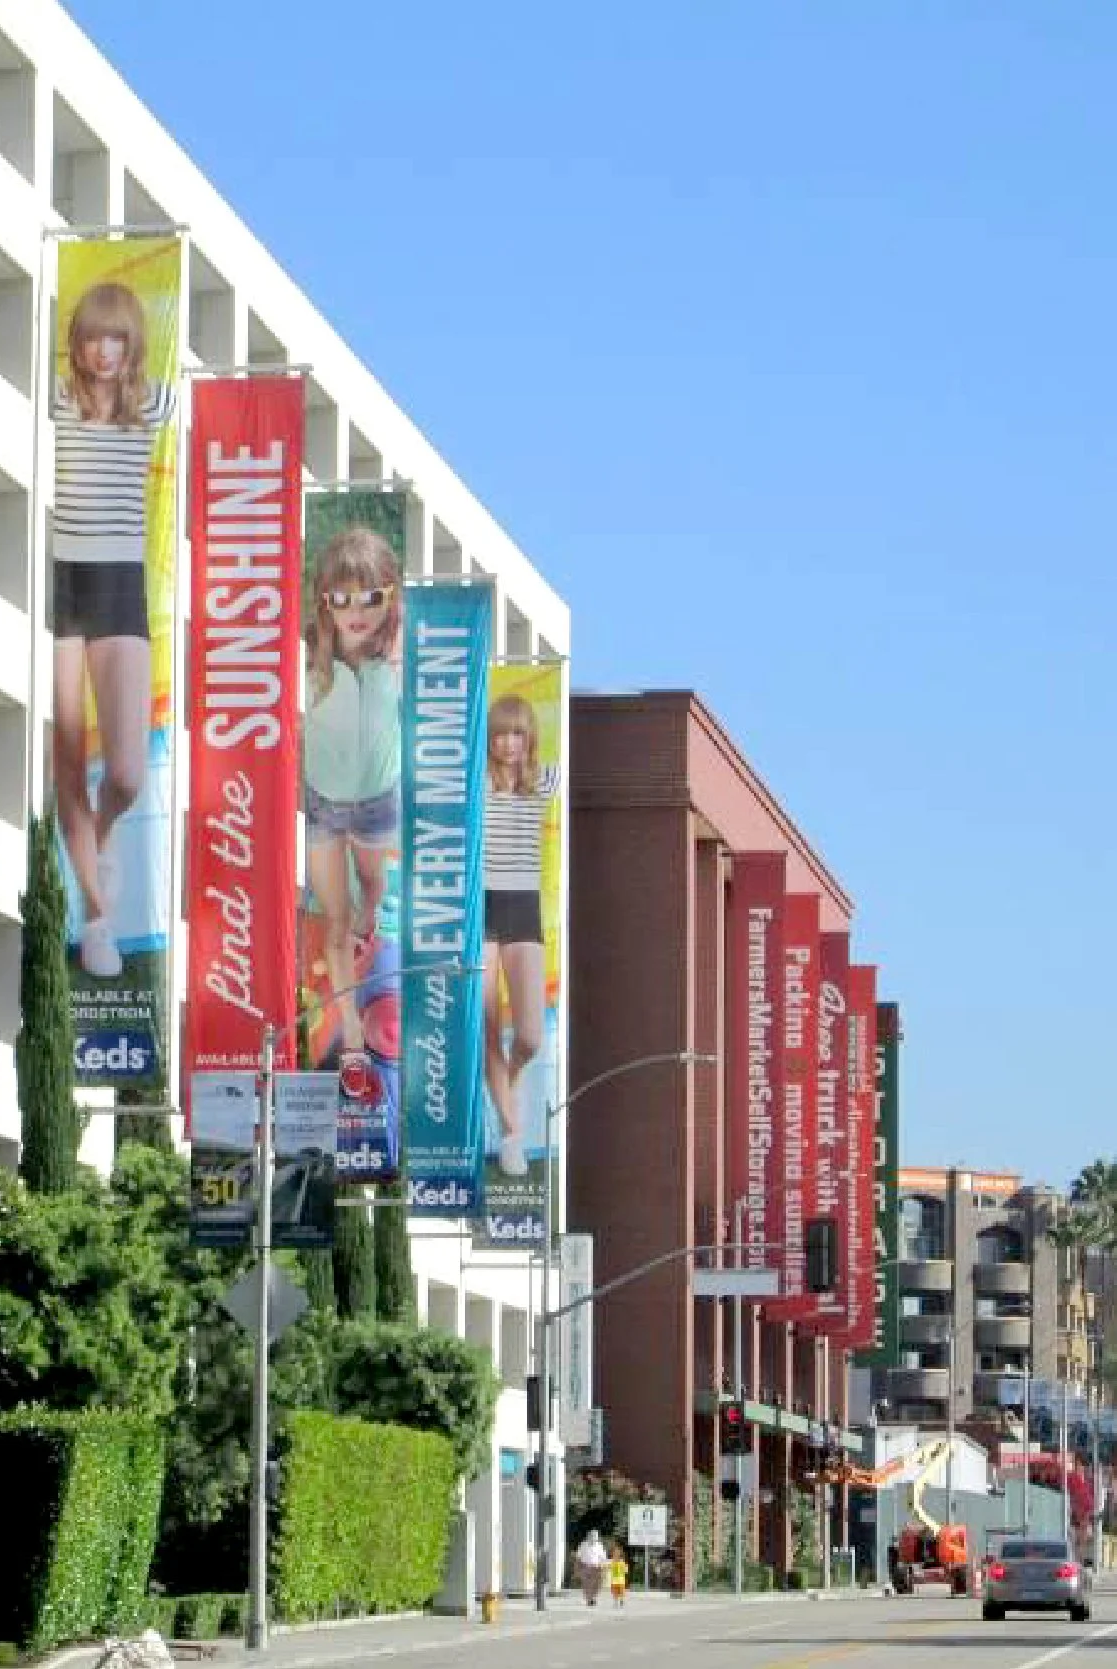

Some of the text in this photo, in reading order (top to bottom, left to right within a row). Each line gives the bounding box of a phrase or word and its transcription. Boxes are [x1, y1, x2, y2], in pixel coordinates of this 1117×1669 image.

[205, 440, 283, 1018] find the SUNSHINE
[413, 620, 472, 805] MOMENT
[413, 819, 466, 951] EVERY
[423, 972, 455, 1021] up
[416, 1027, 447, 1123] soak
[817, 1069, 846, 1145] truck
[407, 1180, 470, 1206] Keds
[487, 1215, 545, 1239] Keds
